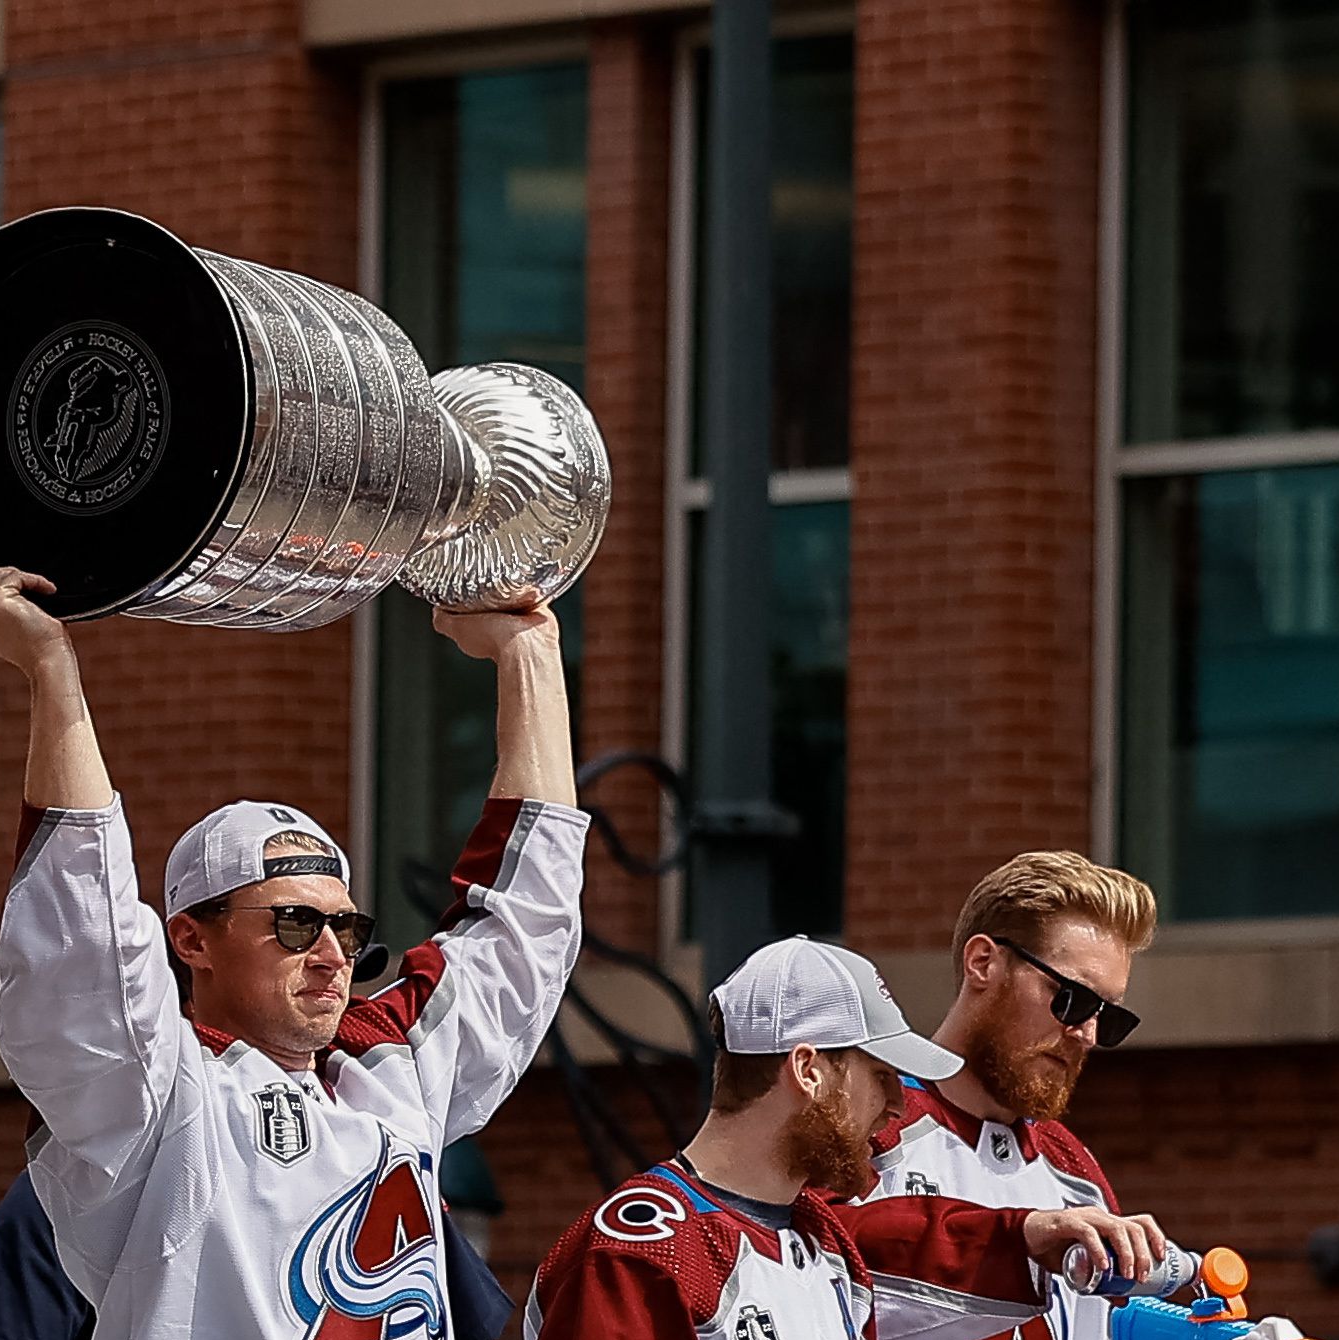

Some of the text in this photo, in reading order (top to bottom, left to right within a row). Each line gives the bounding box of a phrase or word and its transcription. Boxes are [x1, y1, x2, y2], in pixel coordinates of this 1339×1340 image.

[88, 333, 138, 363] HOCKEY
[134, 359, 157, 398] HALL
[140, 417, 160, 460] FAME
[85, 466, 136, 503] HOCKEY
